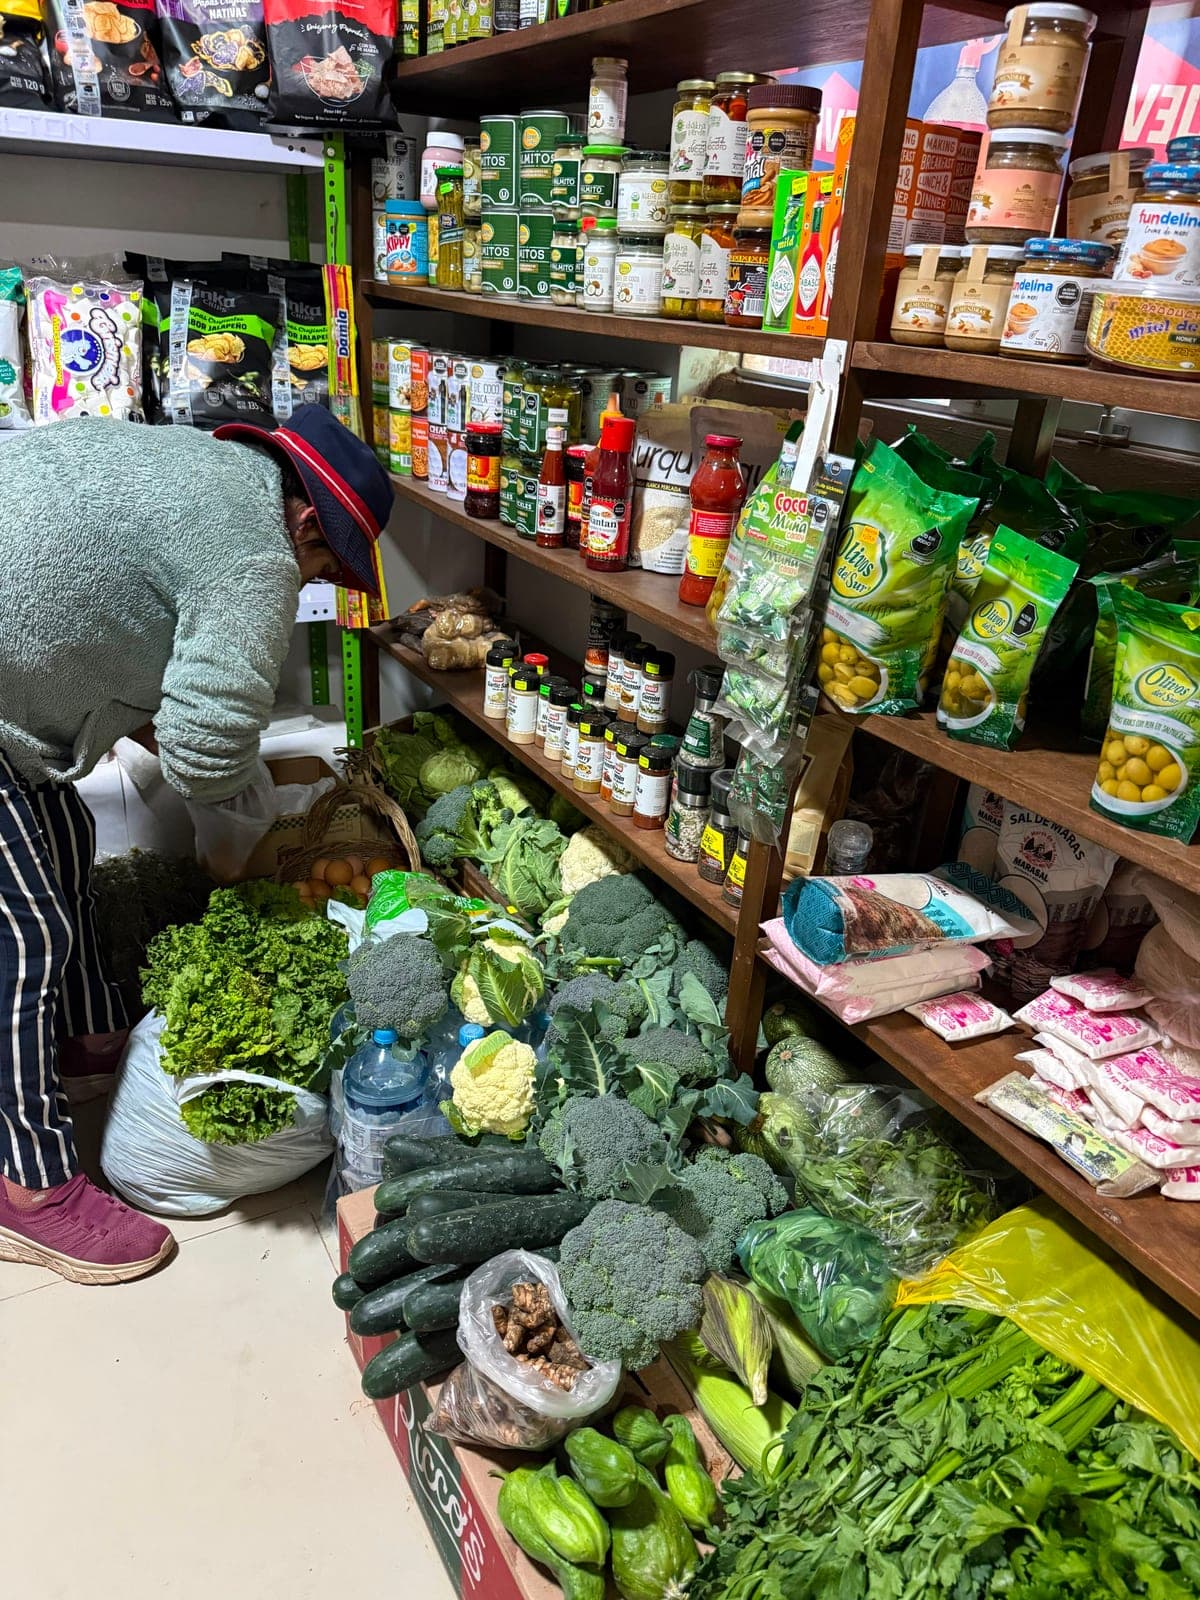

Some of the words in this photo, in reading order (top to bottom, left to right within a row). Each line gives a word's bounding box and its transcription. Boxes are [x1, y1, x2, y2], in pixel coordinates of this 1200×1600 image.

[209, 7, 248, 19] NATIVAS
[23, 78, 38, 91] 120
[926, 137, 956, 152] MAKING
[920, 153, 955, 170] BREAKFAST
[918, 176, 941, 191] LUNCH
[914, 190, 947, 209] DINNER
[777, 238, 795, 250] mild
[208, 322, 248, 332] JALAPEÑO
[337, 309, 349, 358] Damla
[1129, 319, 1170, 339] miel
[1176, 320, 1199, 332] de
[1175, 335, 1198, 344] HONEY
[775, 492, 808, 514] Coca
[769, 512, 808, 534] Muña
[838, 526, 875, 578] Olivos
[836, 565, 850, 580] del
[845, 571, 868, 594] Sur
[978, 601, 1006, 627] Olivos
[1144, 667, 1190, 696] Olivos
[1151, 688, 1164, 698] del
[1009, 812, 1033, 826] SAL
[1049, 821, 1086, 862] MARAS
[1012, 856, 1050, 884] MARASAL
